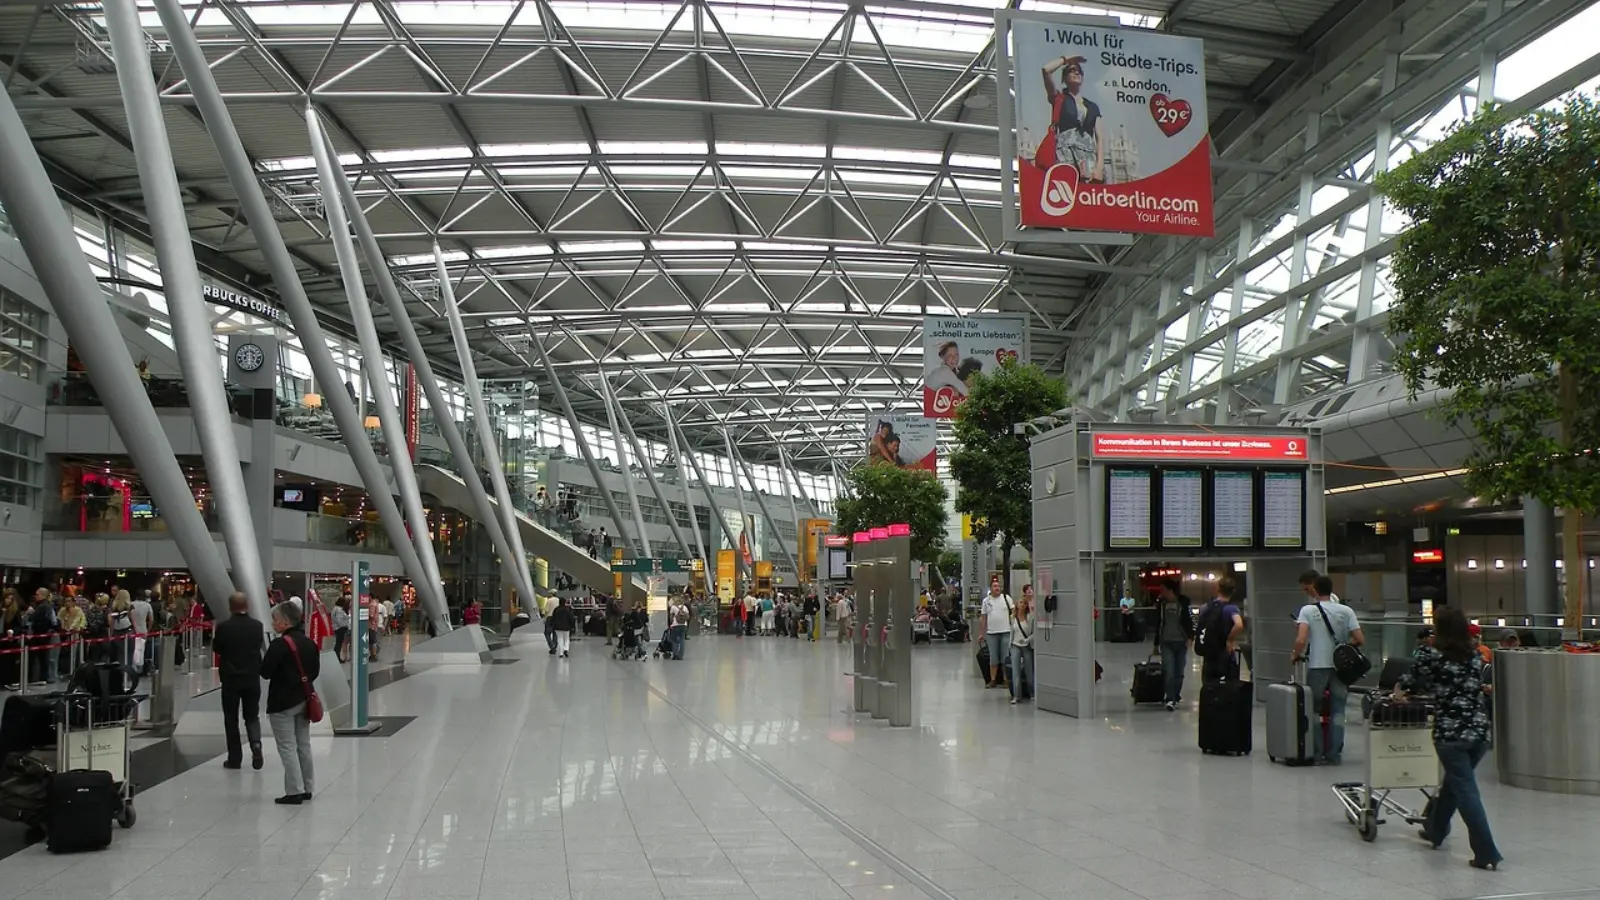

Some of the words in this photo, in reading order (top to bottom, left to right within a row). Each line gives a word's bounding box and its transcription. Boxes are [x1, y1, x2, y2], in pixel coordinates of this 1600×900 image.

[1044, 28, 1055, 43] 1.
[1056, 30, 1098, 48] Wahl
[1103, 34, 1125, 50] für
[1100, 52, 1199, 77] Städte-Trips.
[1121, 77, 1171, 94] London,
[1116, 91, 1146, 104] Rom
[1078, 188, 1199, 213] airberlin.com
[1136, 211, 1161, 224] Your
[1163, 214, 1200, 226] Airline.
[250, 299, 280, 320] COFFEE
[944, 321, 966, 329] Wahl
[967, 321, 979, 329] für
[970, 348, 994, 356] Europa
[1098, 438, 1152, 446] Kommunikation
[1182, 439, 1211, 448] Business
[971, 541, 979, 584] Information
